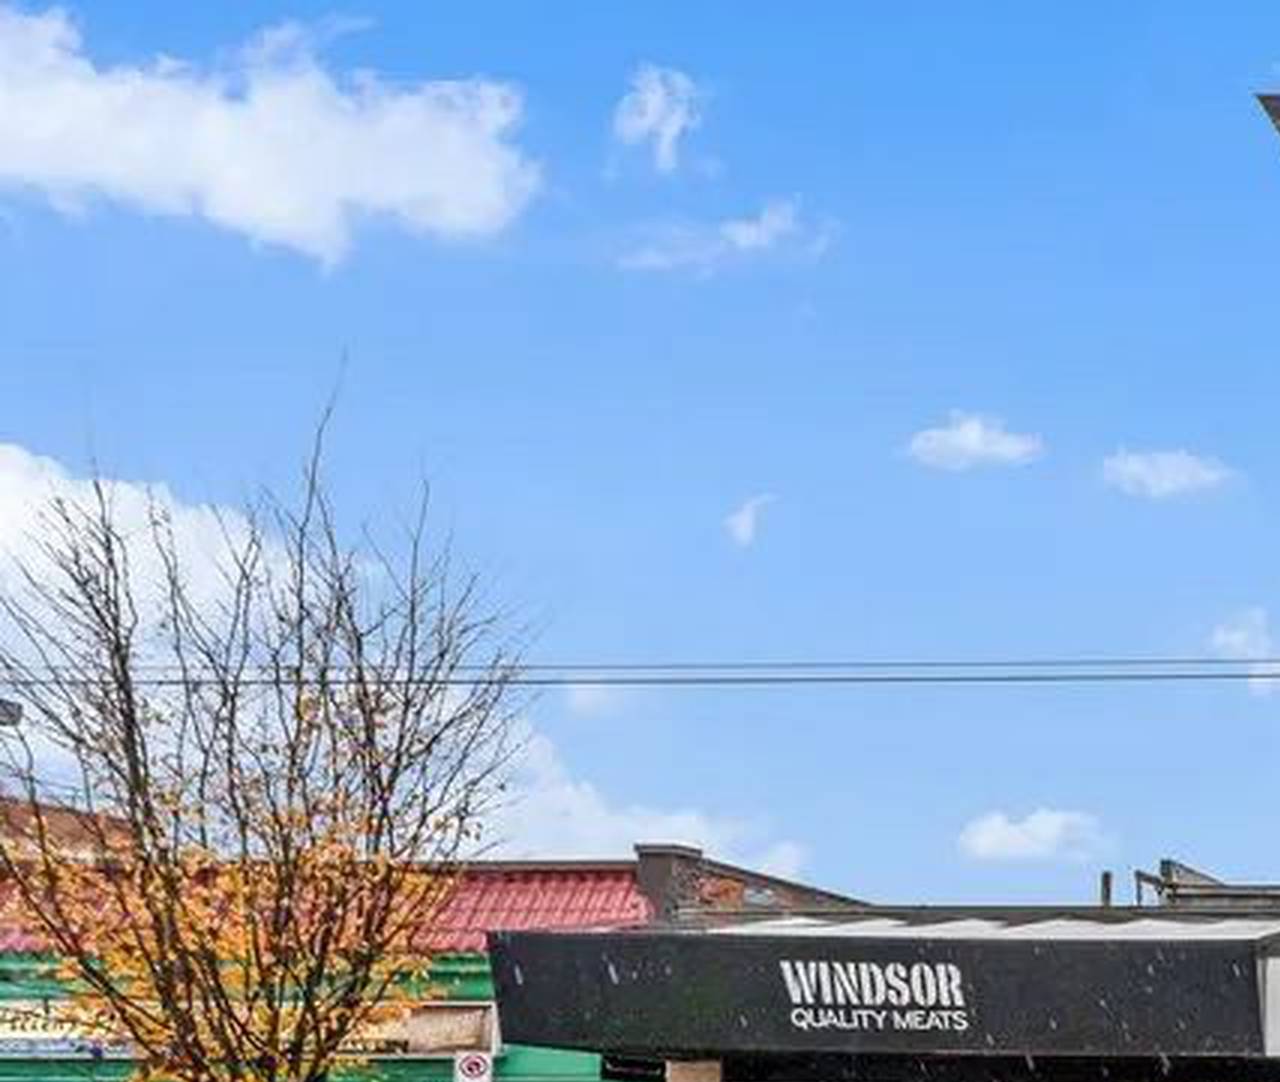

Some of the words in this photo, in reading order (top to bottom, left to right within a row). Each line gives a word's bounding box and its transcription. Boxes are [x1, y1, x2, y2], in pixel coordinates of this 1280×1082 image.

[779, 959, 966, 1008] WINDSOR
[790, 1007, 887, 1031] QUALITY
[892, 1009, 970, 1031] MEATS
